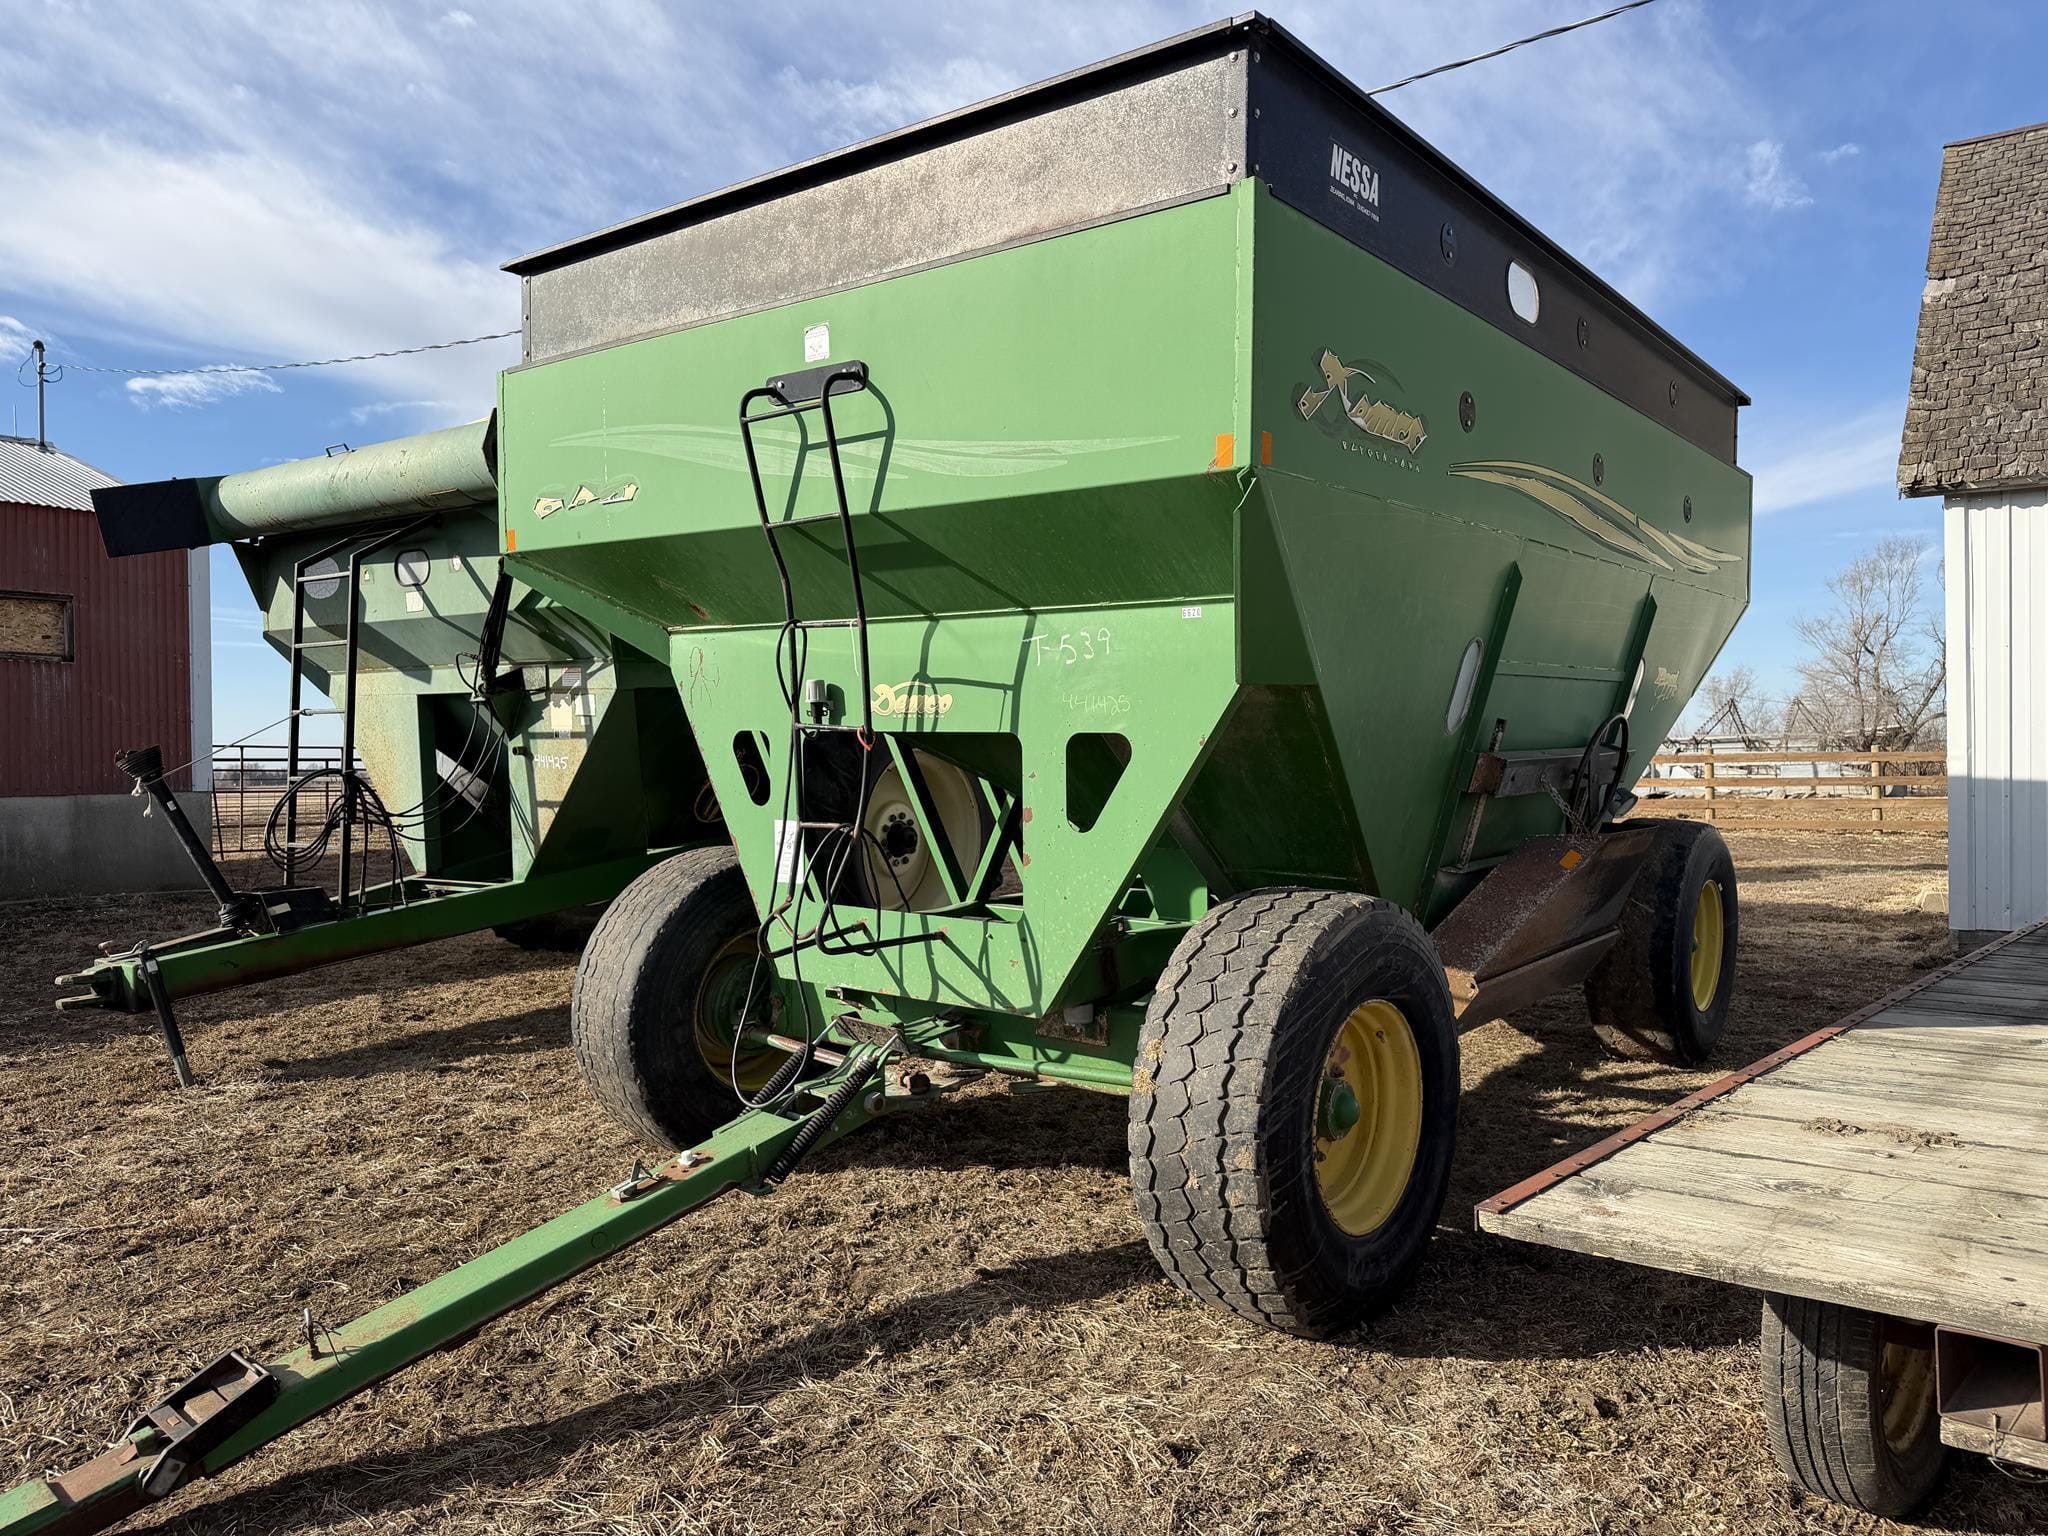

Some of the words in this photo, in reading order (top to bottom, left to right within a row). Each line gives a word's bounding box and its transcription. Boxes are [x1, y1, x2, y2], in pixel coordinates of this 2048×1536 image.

[1330, 143, 1379, 207] NESSA
[1022, 627, 1111, 667] T-539
[871, 681, 953, 716] Demco
[1062, 693, 1131, 716] 441425
[533, 753, 569, 770] 441425
